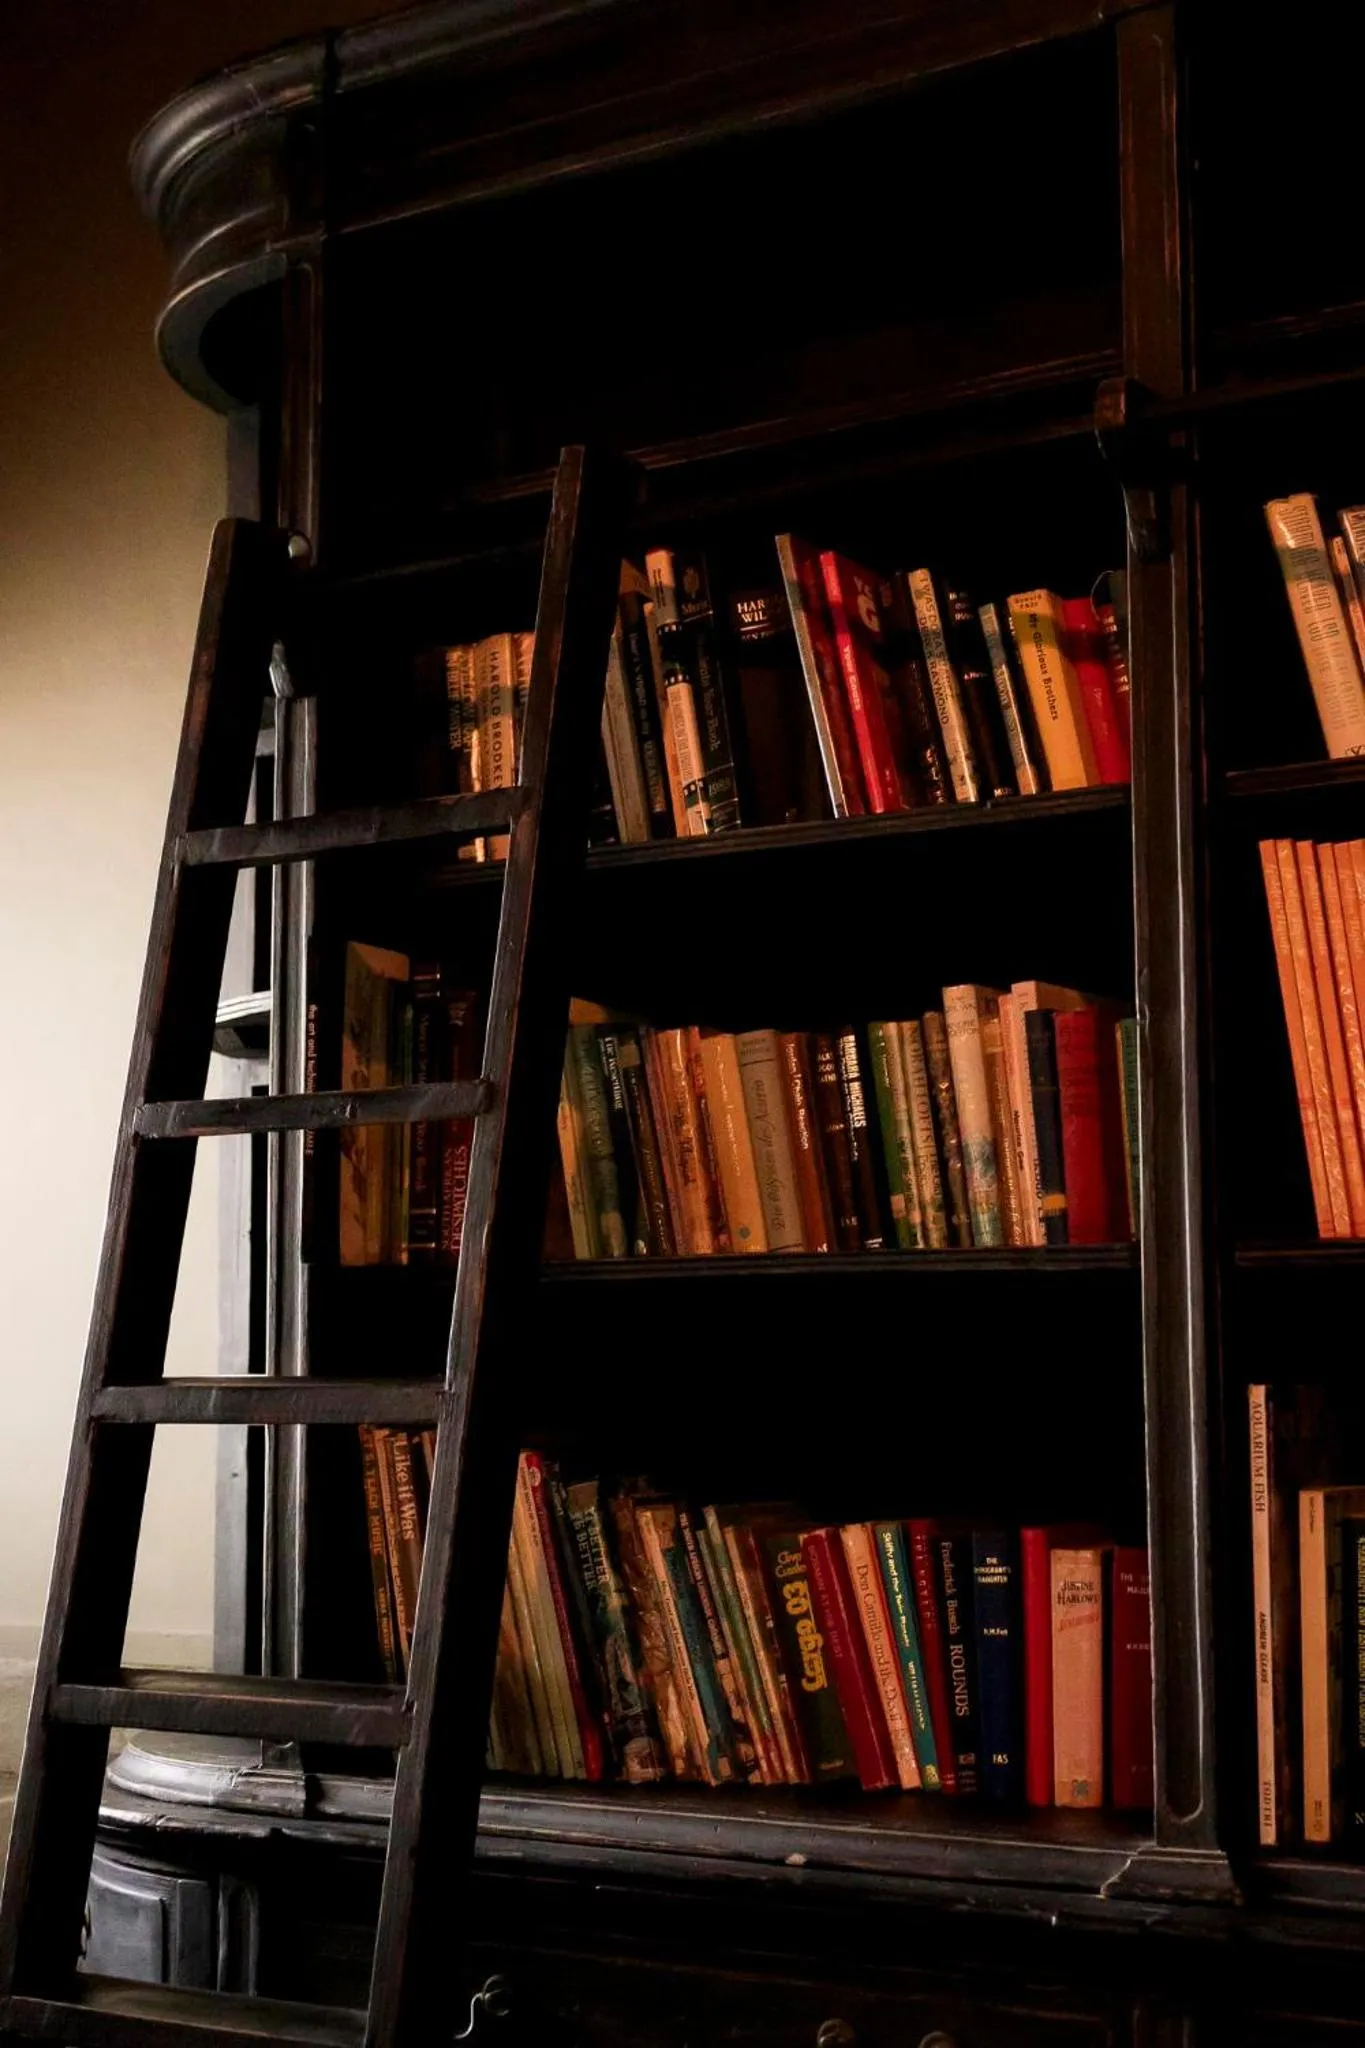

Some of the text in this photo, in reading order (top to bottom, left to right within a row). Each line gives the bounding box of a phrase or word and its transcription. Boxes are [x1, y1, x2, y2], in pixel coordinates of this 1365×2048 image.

[923, 584, 936, 613] WAS
[489, 651, 501, 716] HAROLD
[930, 660, 950, 725] RAYMOND
[1033, 631, 1049, 675] Glorious
[1043, 677, 1059, 721] Brothers
[842, 1034, 861, 1080] BARBARA
[848, 1080, 867, 1128] MICHAELS
[1251, 1401, 1265, 1512] AQUARIUM FISH
[393, 1437, 419, 1541] Like it Was
[369, 1515, 383, 1553] MUSIC
[856, 1564, 870, 1590] Don
[941, 1541, 956, 1596] Frederick
[862, 1593, 881, 1639] Camillo
[948, 1642, 970, 1717] ROUNDS
[992, 1753, 1009, 1764] FAS
